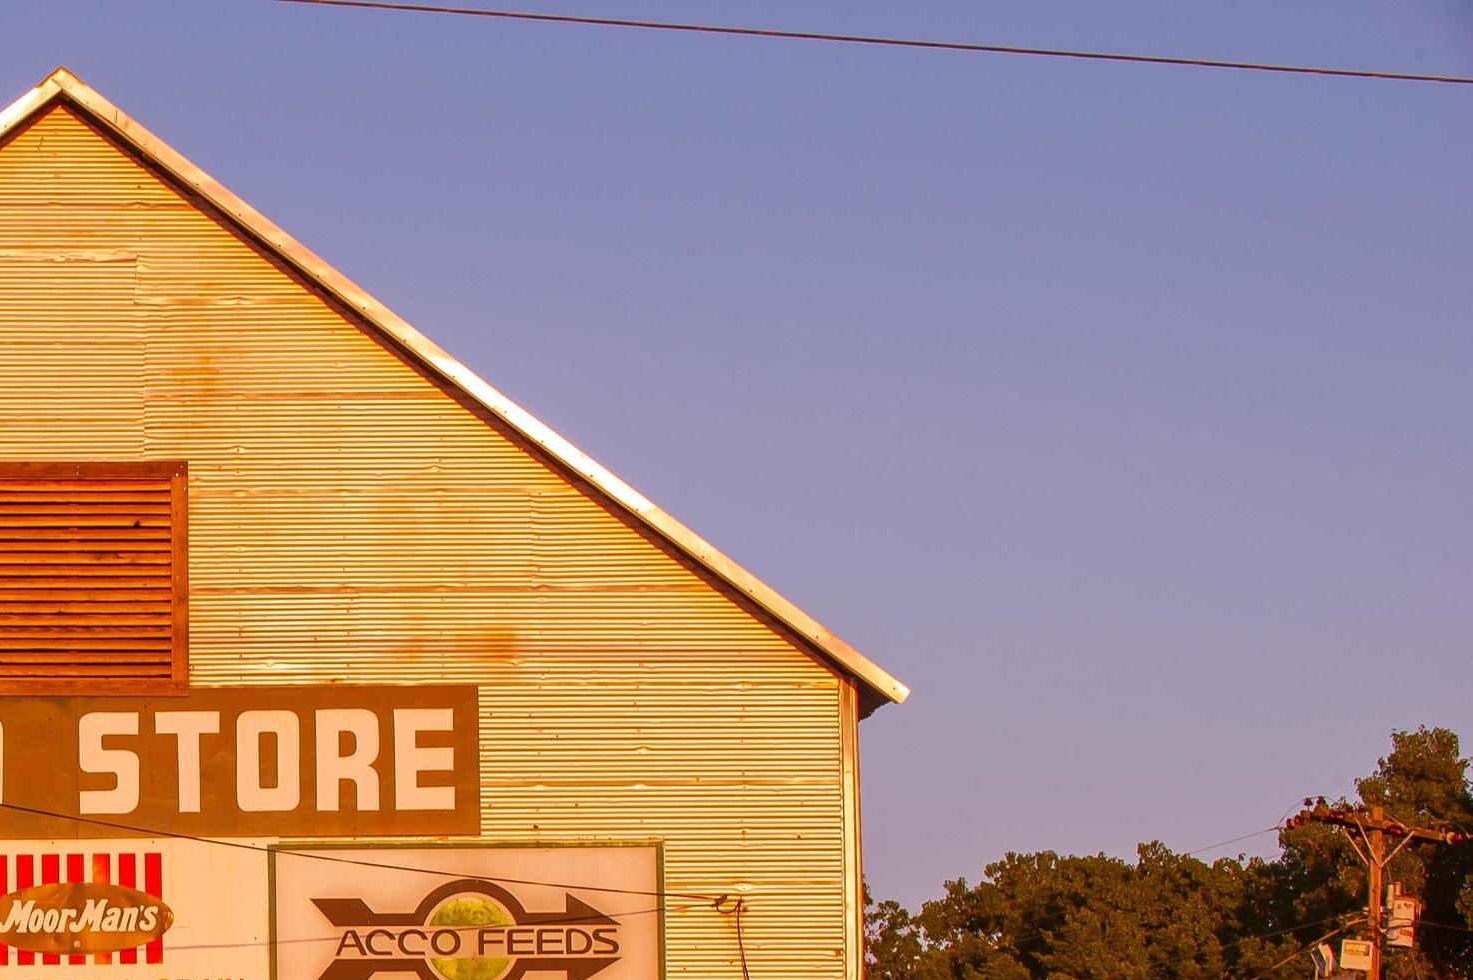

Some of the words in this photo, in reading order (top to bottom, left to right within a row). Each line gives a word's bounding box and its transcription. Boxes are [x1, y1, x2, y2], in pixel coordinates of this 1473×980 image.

[78, 708, 456, 814] STORE
[335, 928, 461, 957] ACCO
[478, 928, 620, 956] FEEDS
